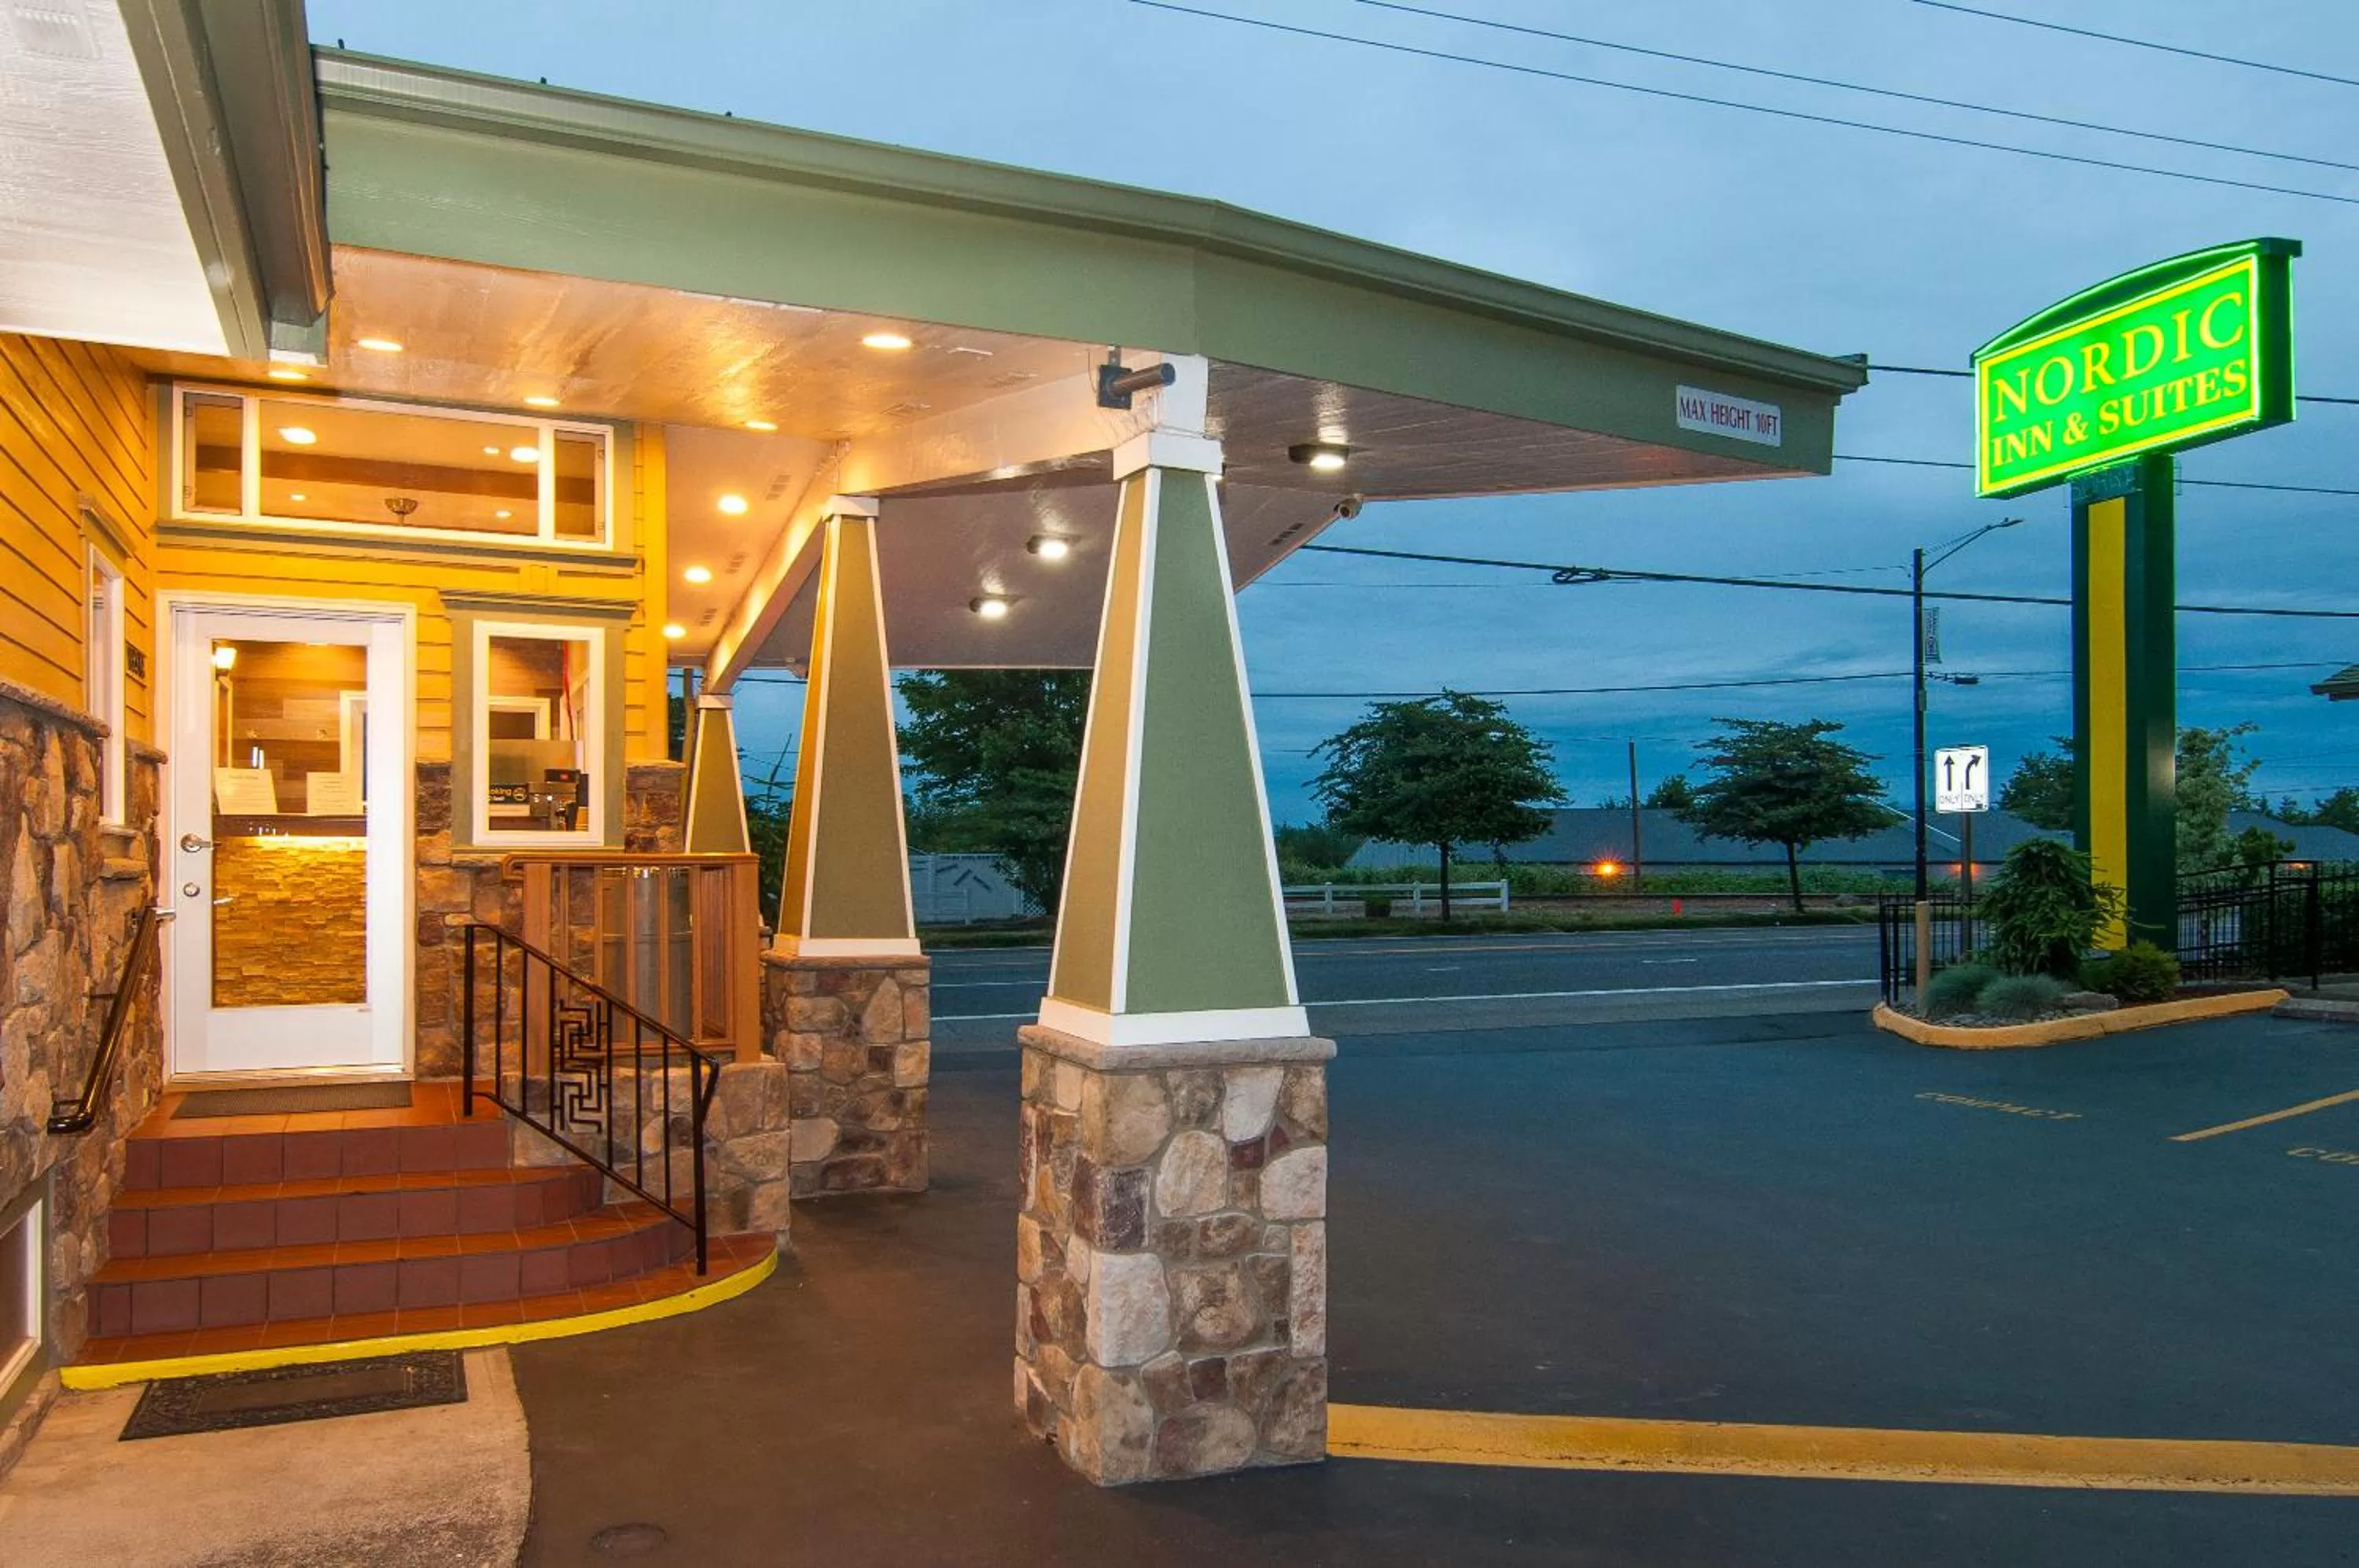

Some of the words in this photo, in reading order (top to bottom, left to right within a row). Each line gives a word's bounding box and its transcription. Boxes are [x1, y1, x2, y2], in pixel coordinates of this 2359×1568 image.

[1993, 291, 2244, 422] NORDIC
[1680, 396, 1706, 422] MAX
[1710, 402, 1751, 431] HEIGHT
[1755, 411, 1779, 436] 10FT
[1991, 421, 2052, 466] INN
[2063, 412, 2089, 445] &
[2099, 359, 2247, 436] SUITES
[1939, 794, 1960, 804] ONLY
[1963, 793, 1983, 803] ONLY
